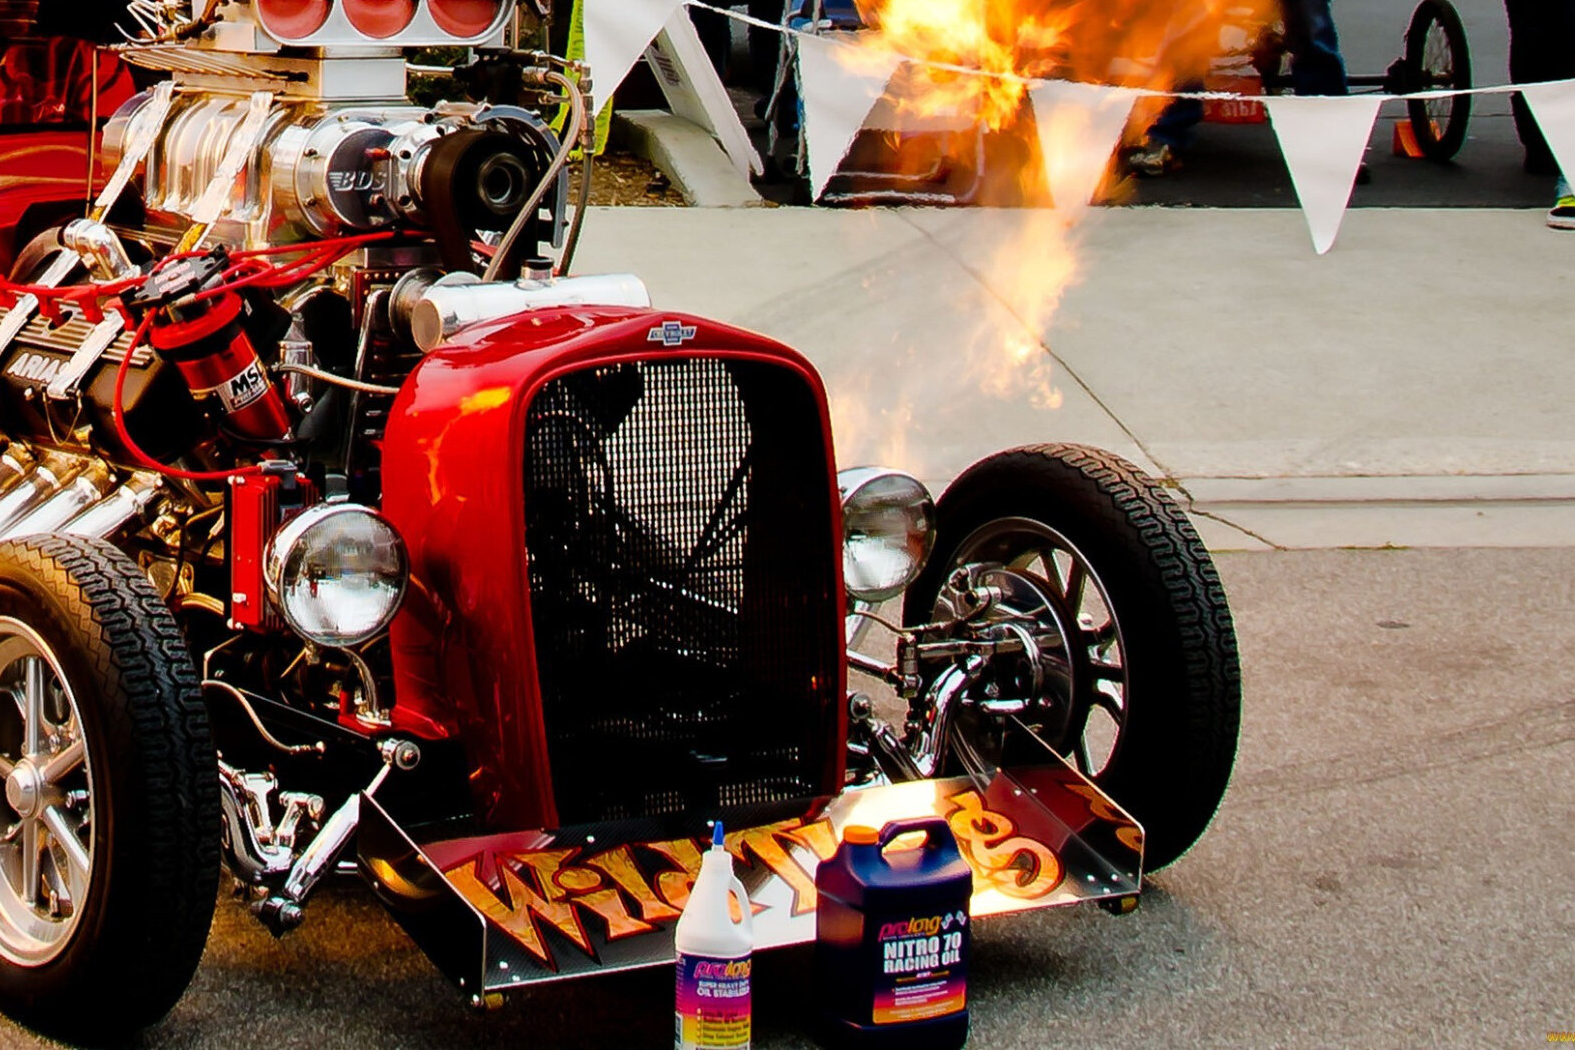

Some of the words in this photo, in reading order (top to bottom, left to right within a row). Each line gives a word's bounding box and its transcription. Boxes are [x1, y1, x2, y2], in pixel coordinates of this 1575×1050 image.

[333, 171, 386, 192] BDS
[878, 915, 943, 942] prolong
[884, 936, 940, 960] NITRO
[943, 931, 962, 951] 70
[883, 953, 940, 973] RACING
[941, 949, 961, 965] OIL
[696, 987, 712, 997] OIL
